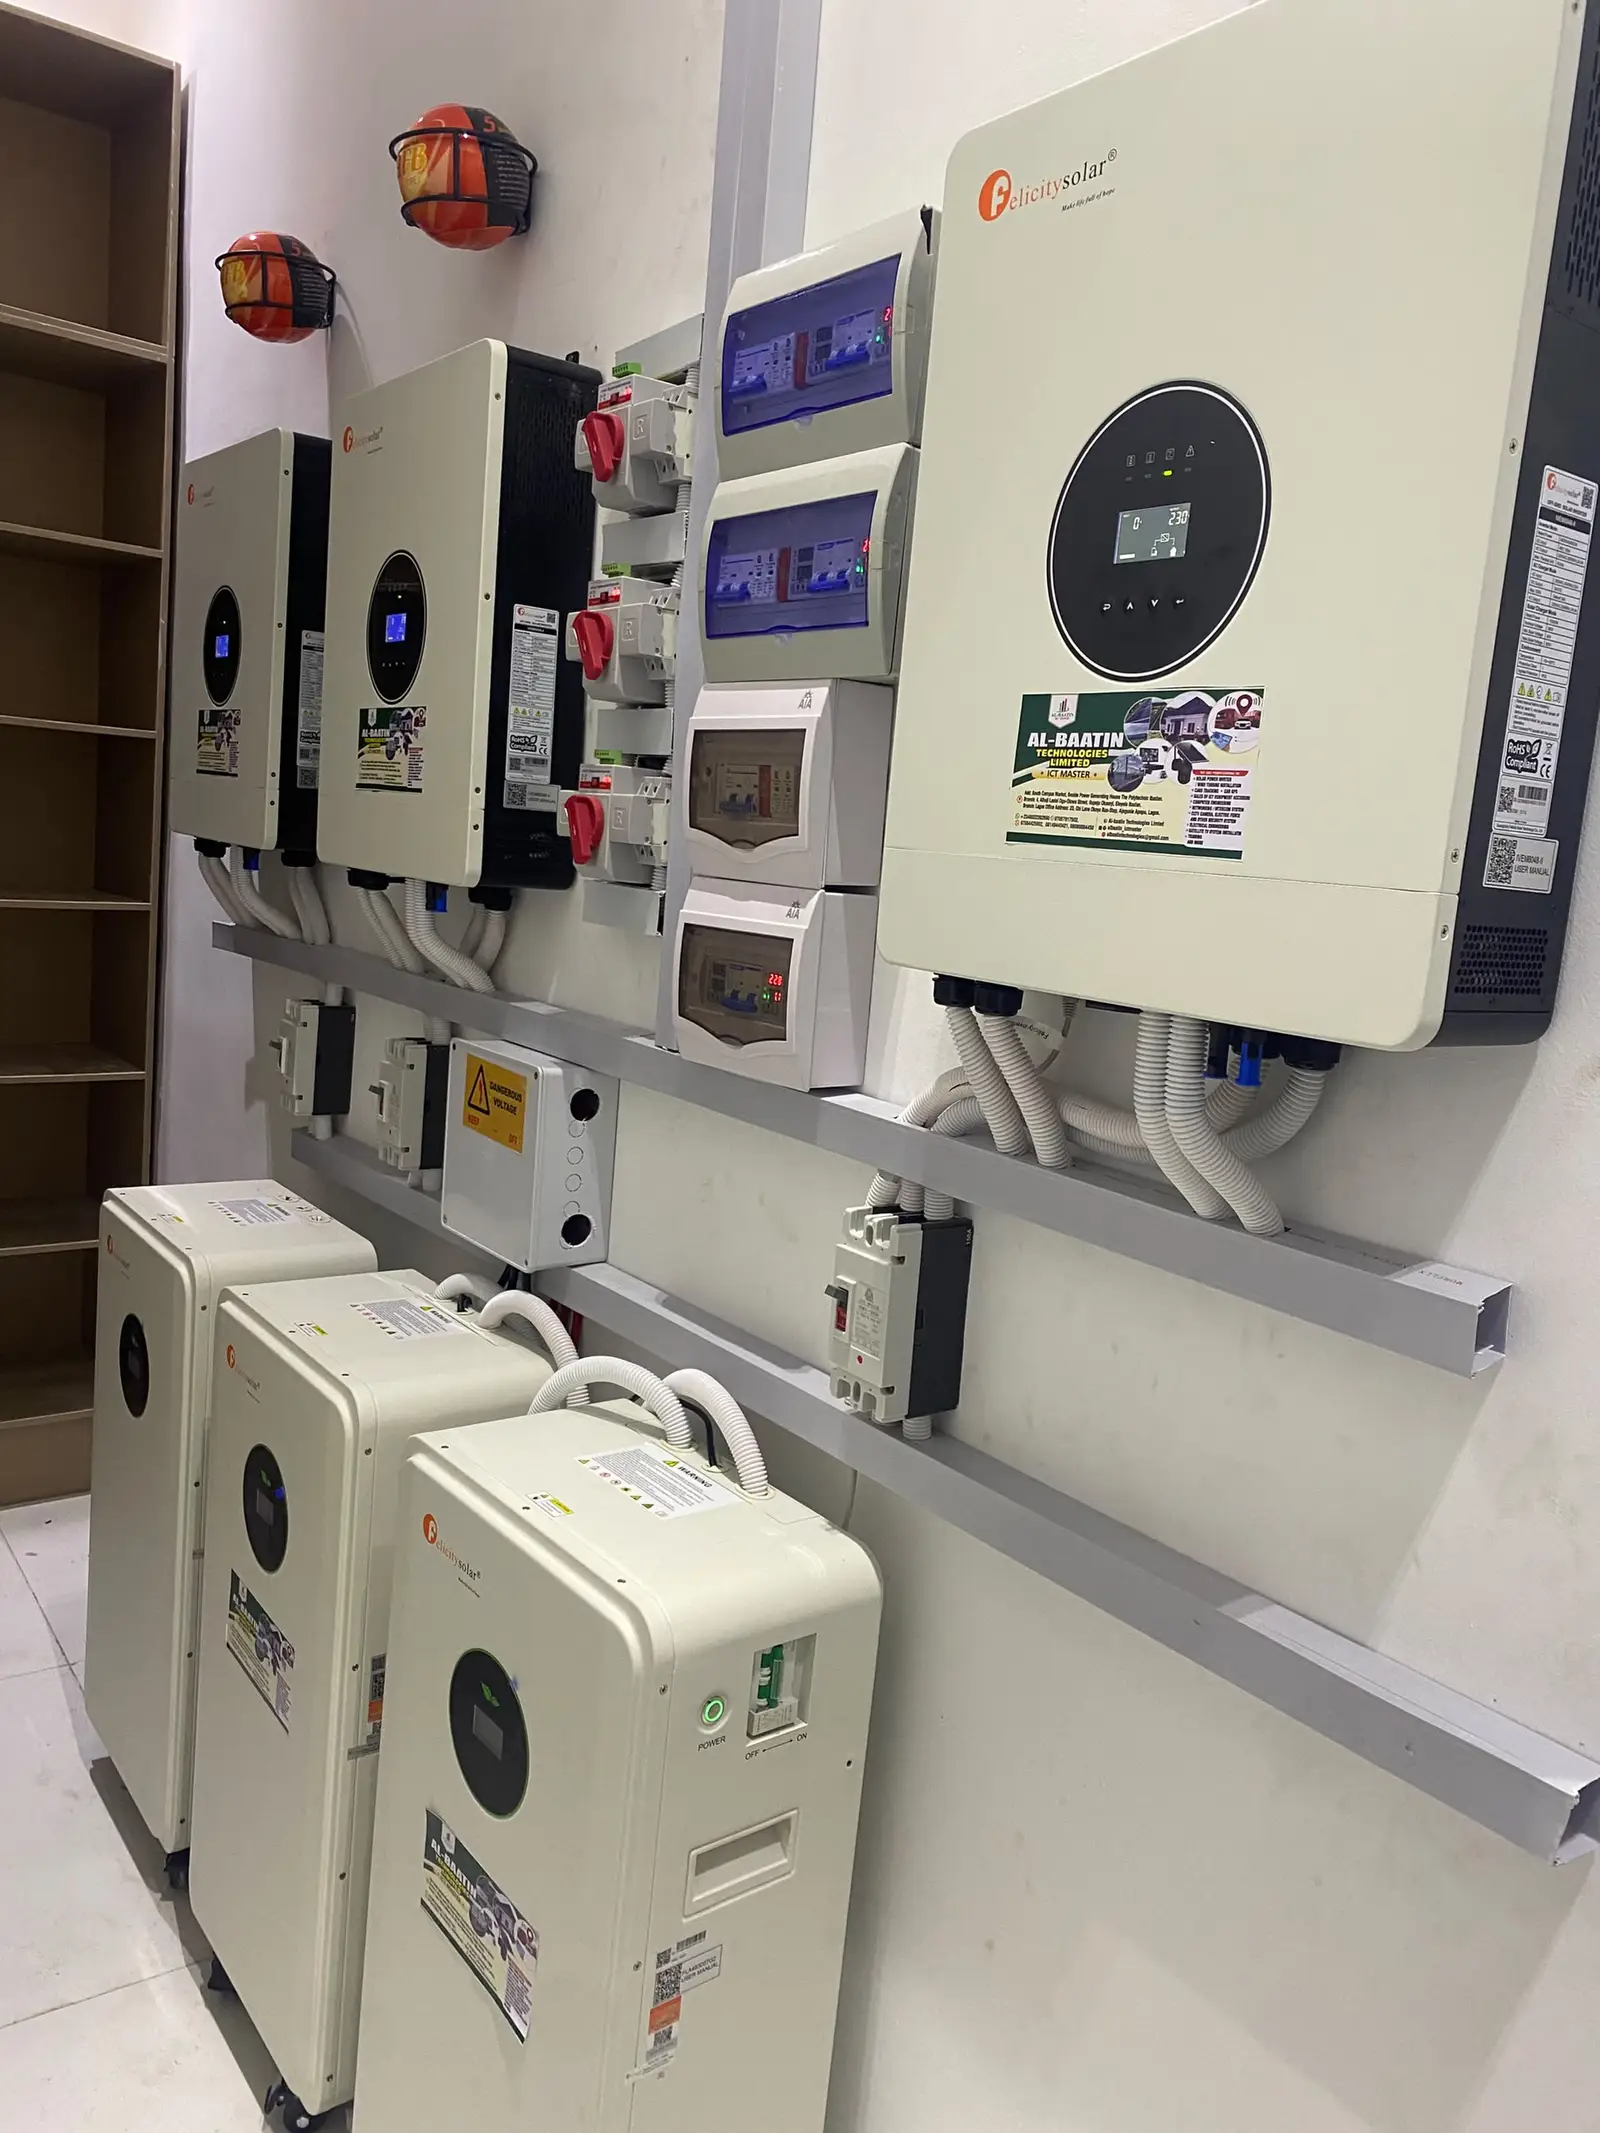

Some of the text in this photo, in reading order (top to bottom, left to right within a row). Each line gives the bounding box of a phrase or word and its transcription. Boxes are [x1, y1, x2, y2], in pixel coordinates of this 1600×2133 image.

[1027, 732, 1124, 748] AL-BAATIN
[1036, 749, 1108, 758] TECHNOLOGIES
[1508, 741, 1526, 756] RoHS
[1050, 758, 1090, 767] LIMITED
[1506, 755, 1537, 771] Compliant
[1047, 770, 1091, 778] ICT MASTER
[1529, 866, 1550, 876] MANUAL
[489, 1080, 522, 1103] DANGEROUS
[494, 1097, 517, 1116] VOLTAGE
[678, 1466, 712, 1488] WARNING
[698, 1735, 726, 1752] POWER
[744, 1732, 808, 1760] OFF ON
[430, 1838, 477, 1899] AL-BAATIN
